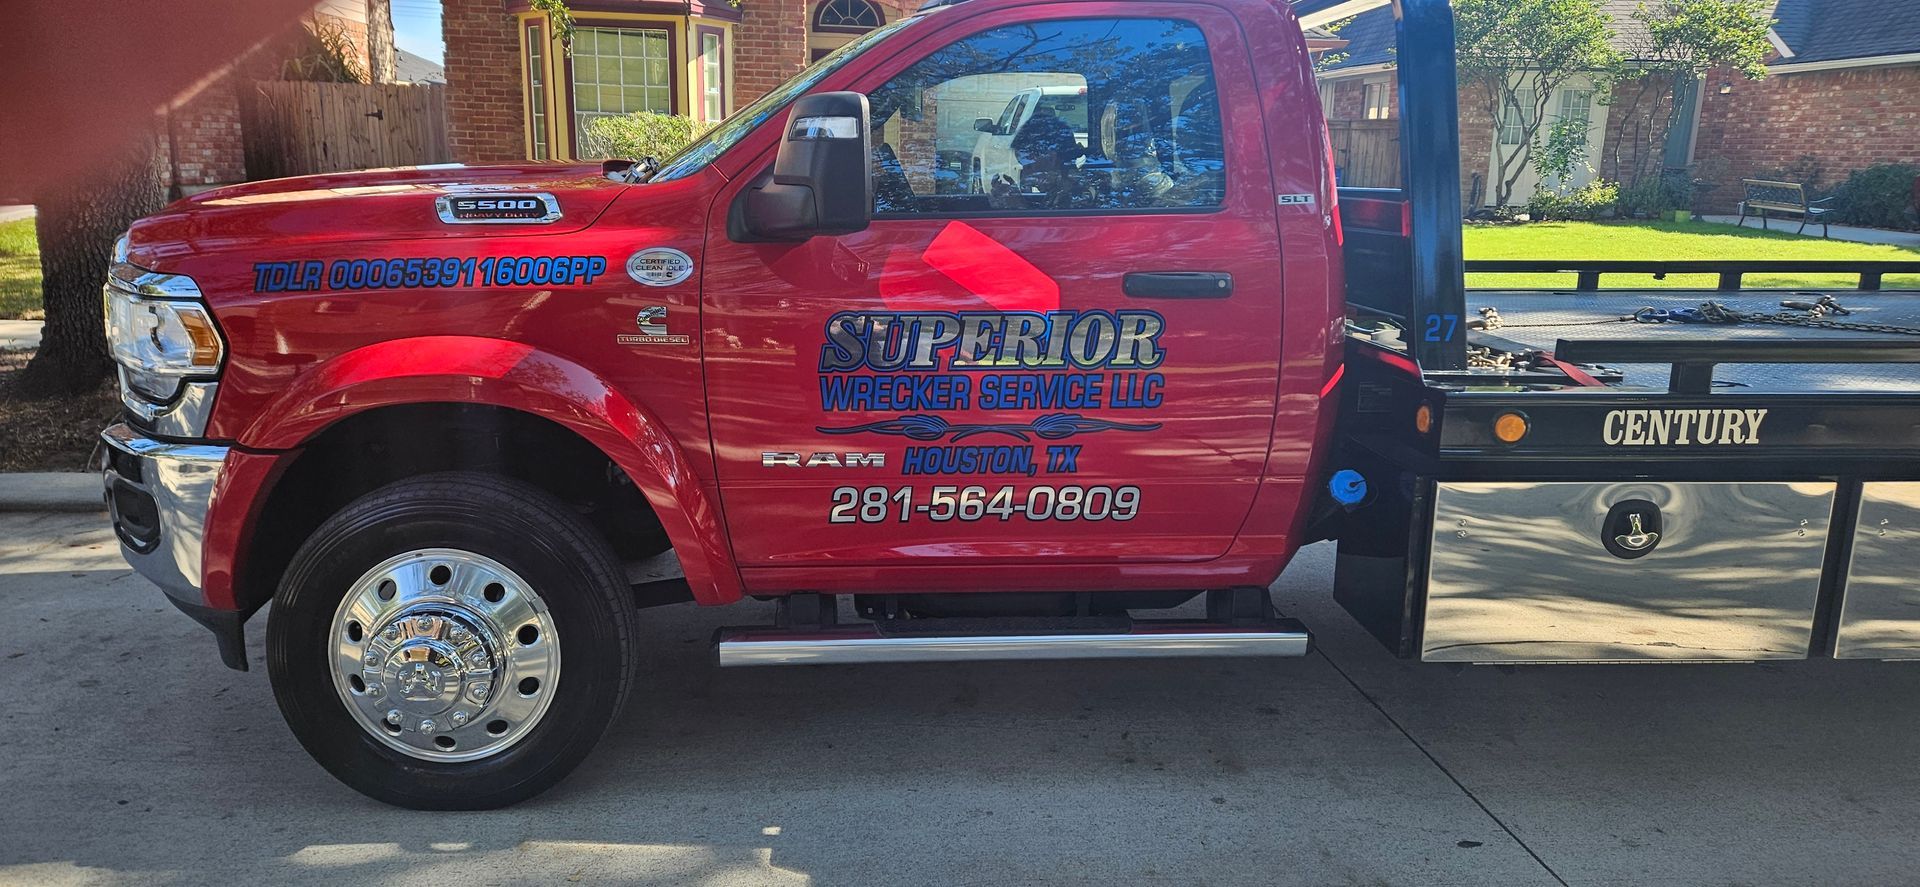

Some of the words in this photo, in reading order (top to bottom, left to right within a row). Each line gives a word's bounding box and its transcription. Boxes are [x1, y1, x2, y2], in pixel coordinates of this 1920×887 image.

[457, 200, 537, 209] 5500
[1281, 195, 1311, 203] SLT
[254, 260, 324, 293] TDLR
[328, 256, 607, 289] 0006539116006PP
[818, 309, 1167, 372] SUPERIOR
[1424, 314, 1458, 342] 27
[819, 375, 971, 411] WRECKER
[979, 374, 1102, 410] SERVICE
[1110, 372, 1165, 409] LLC
[1603, 408, 1768, 446] CENTURY
[761, 451, 885, 468] RAM
[902, 445, 1037, 476] HOUSTON,
[1045, 445, 1083, 474] TX
[828, 485, 1142, 524] 281-564-0809
